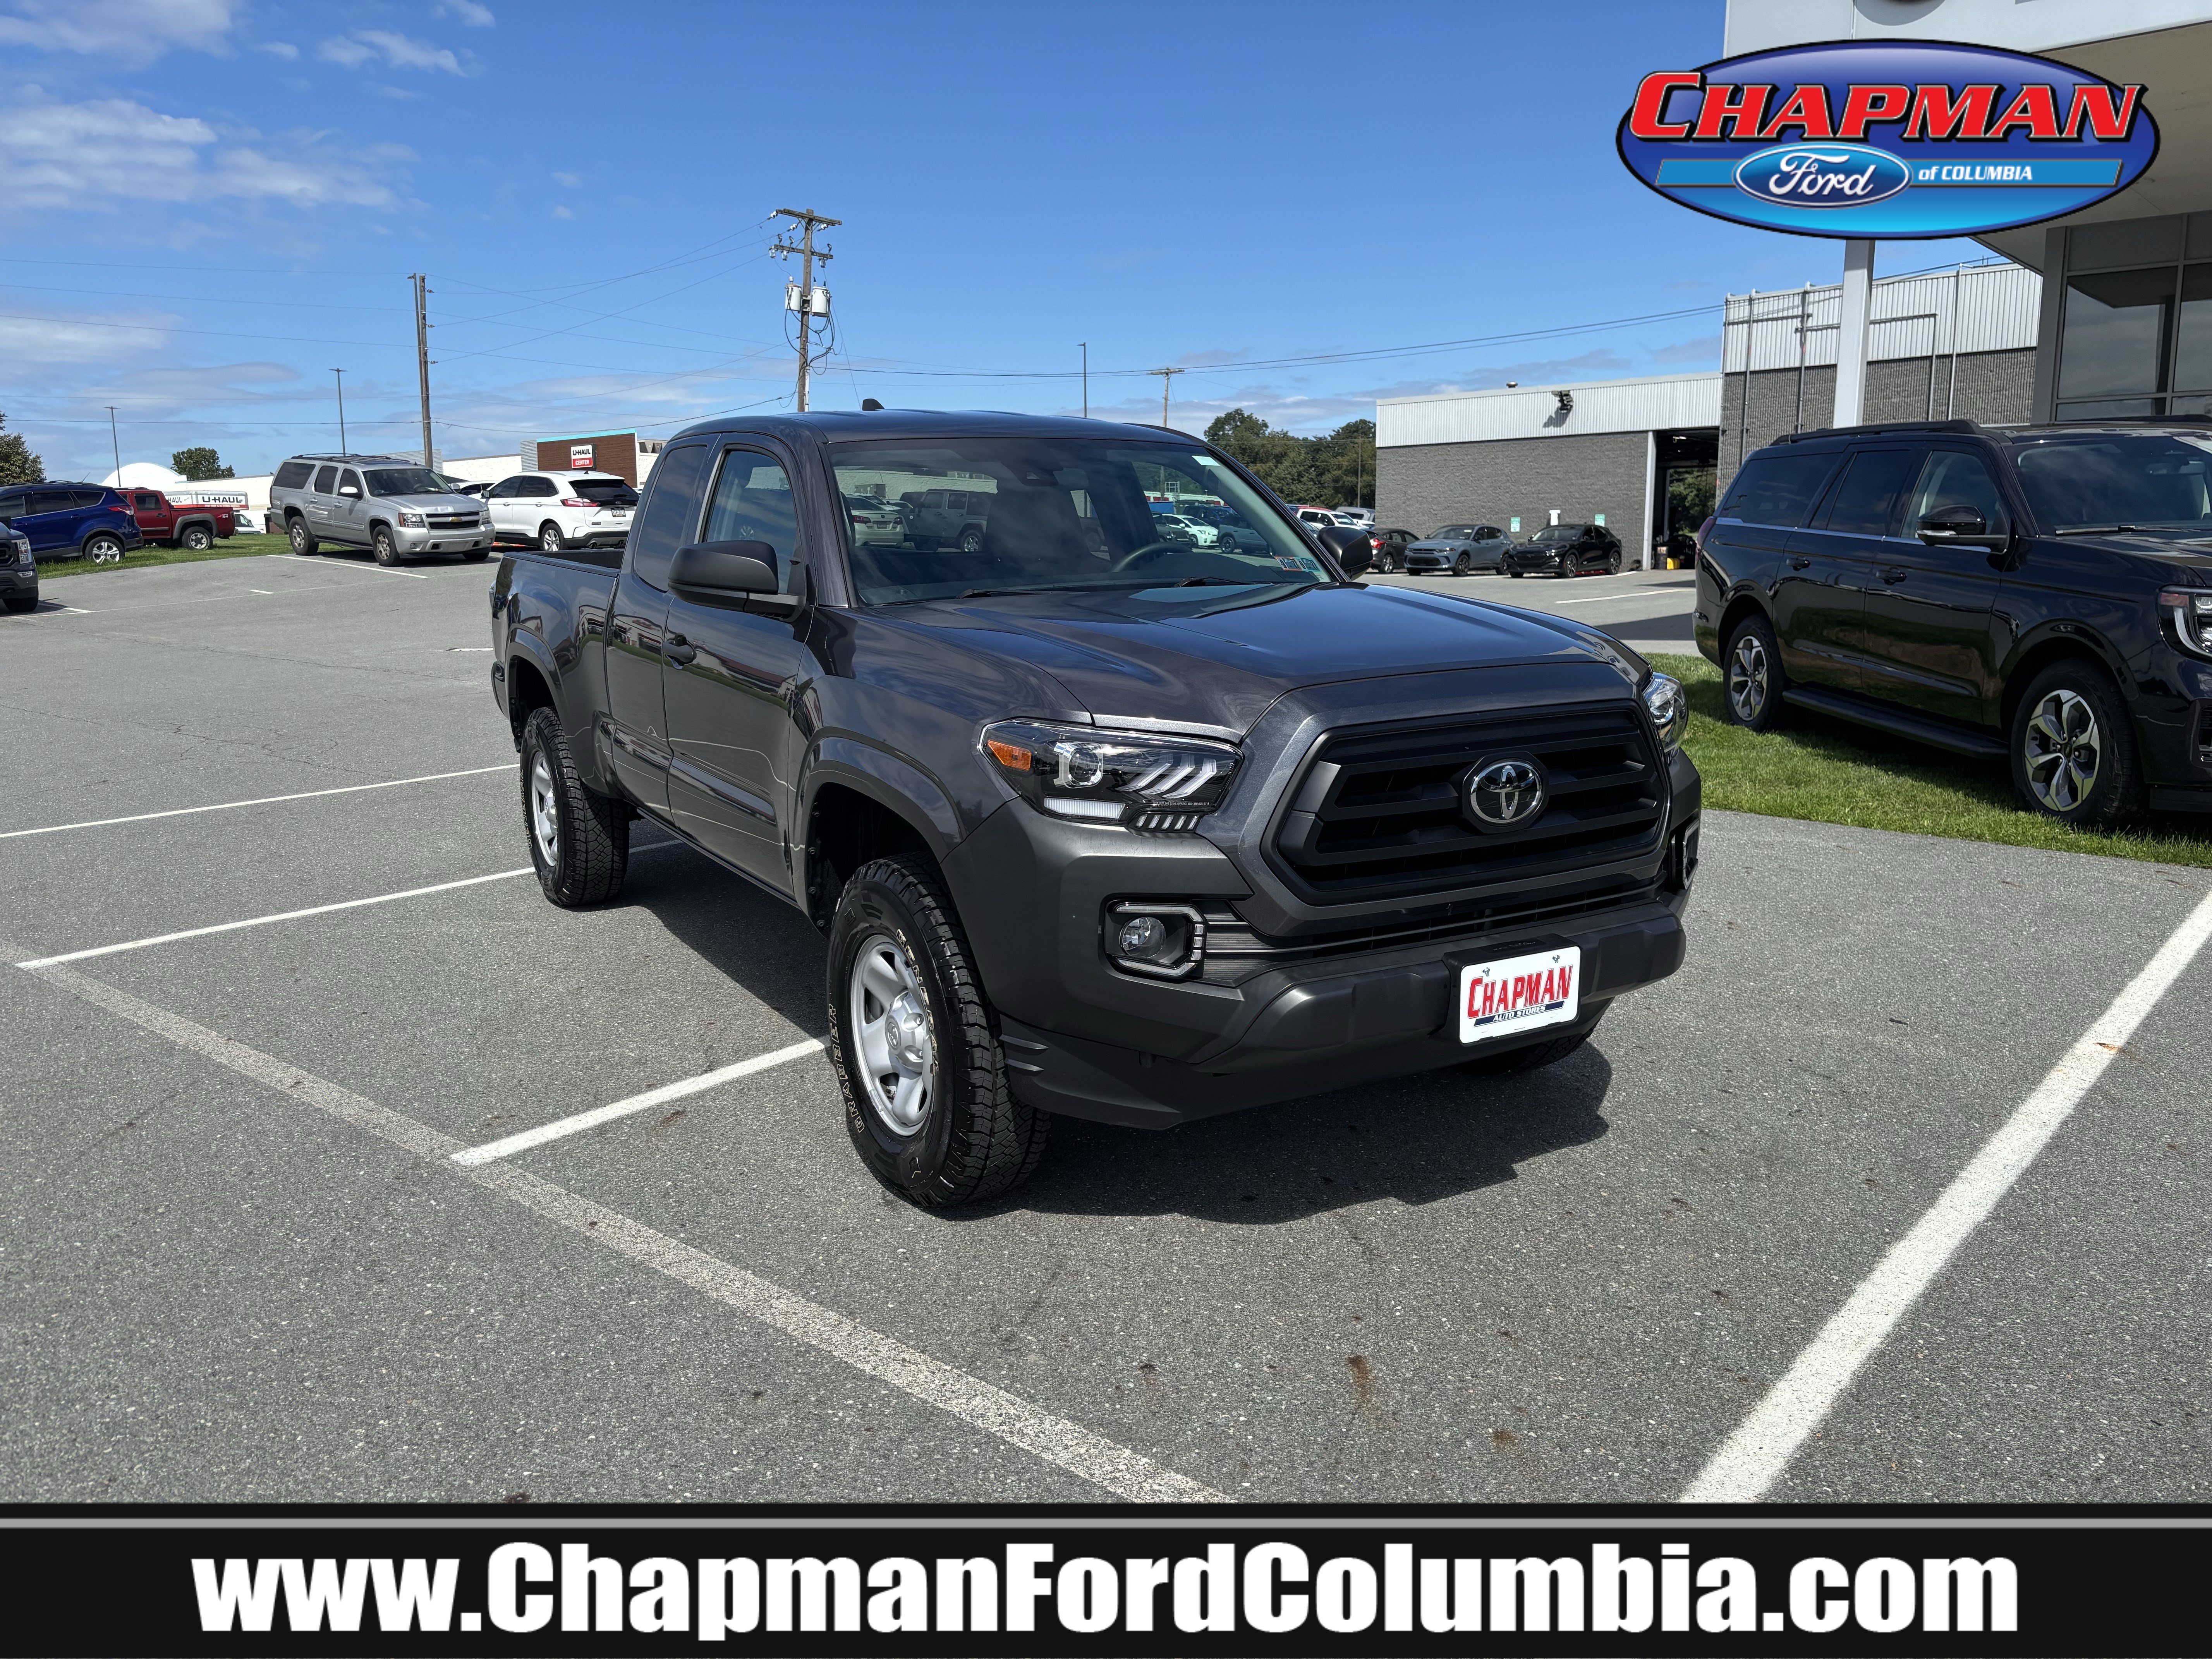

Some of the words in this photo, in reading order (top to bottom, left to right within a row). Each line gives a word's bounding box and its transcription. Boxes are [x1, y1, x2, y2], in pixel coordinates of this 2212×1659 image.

[1467, 965, 1573, 1019] CHAPMAN
[1492, 1013, 1515, 1022] AUTO
[1516, 1005, 1546, 1017] STORES
[829, 1004, 865, 1132] GRABBER
